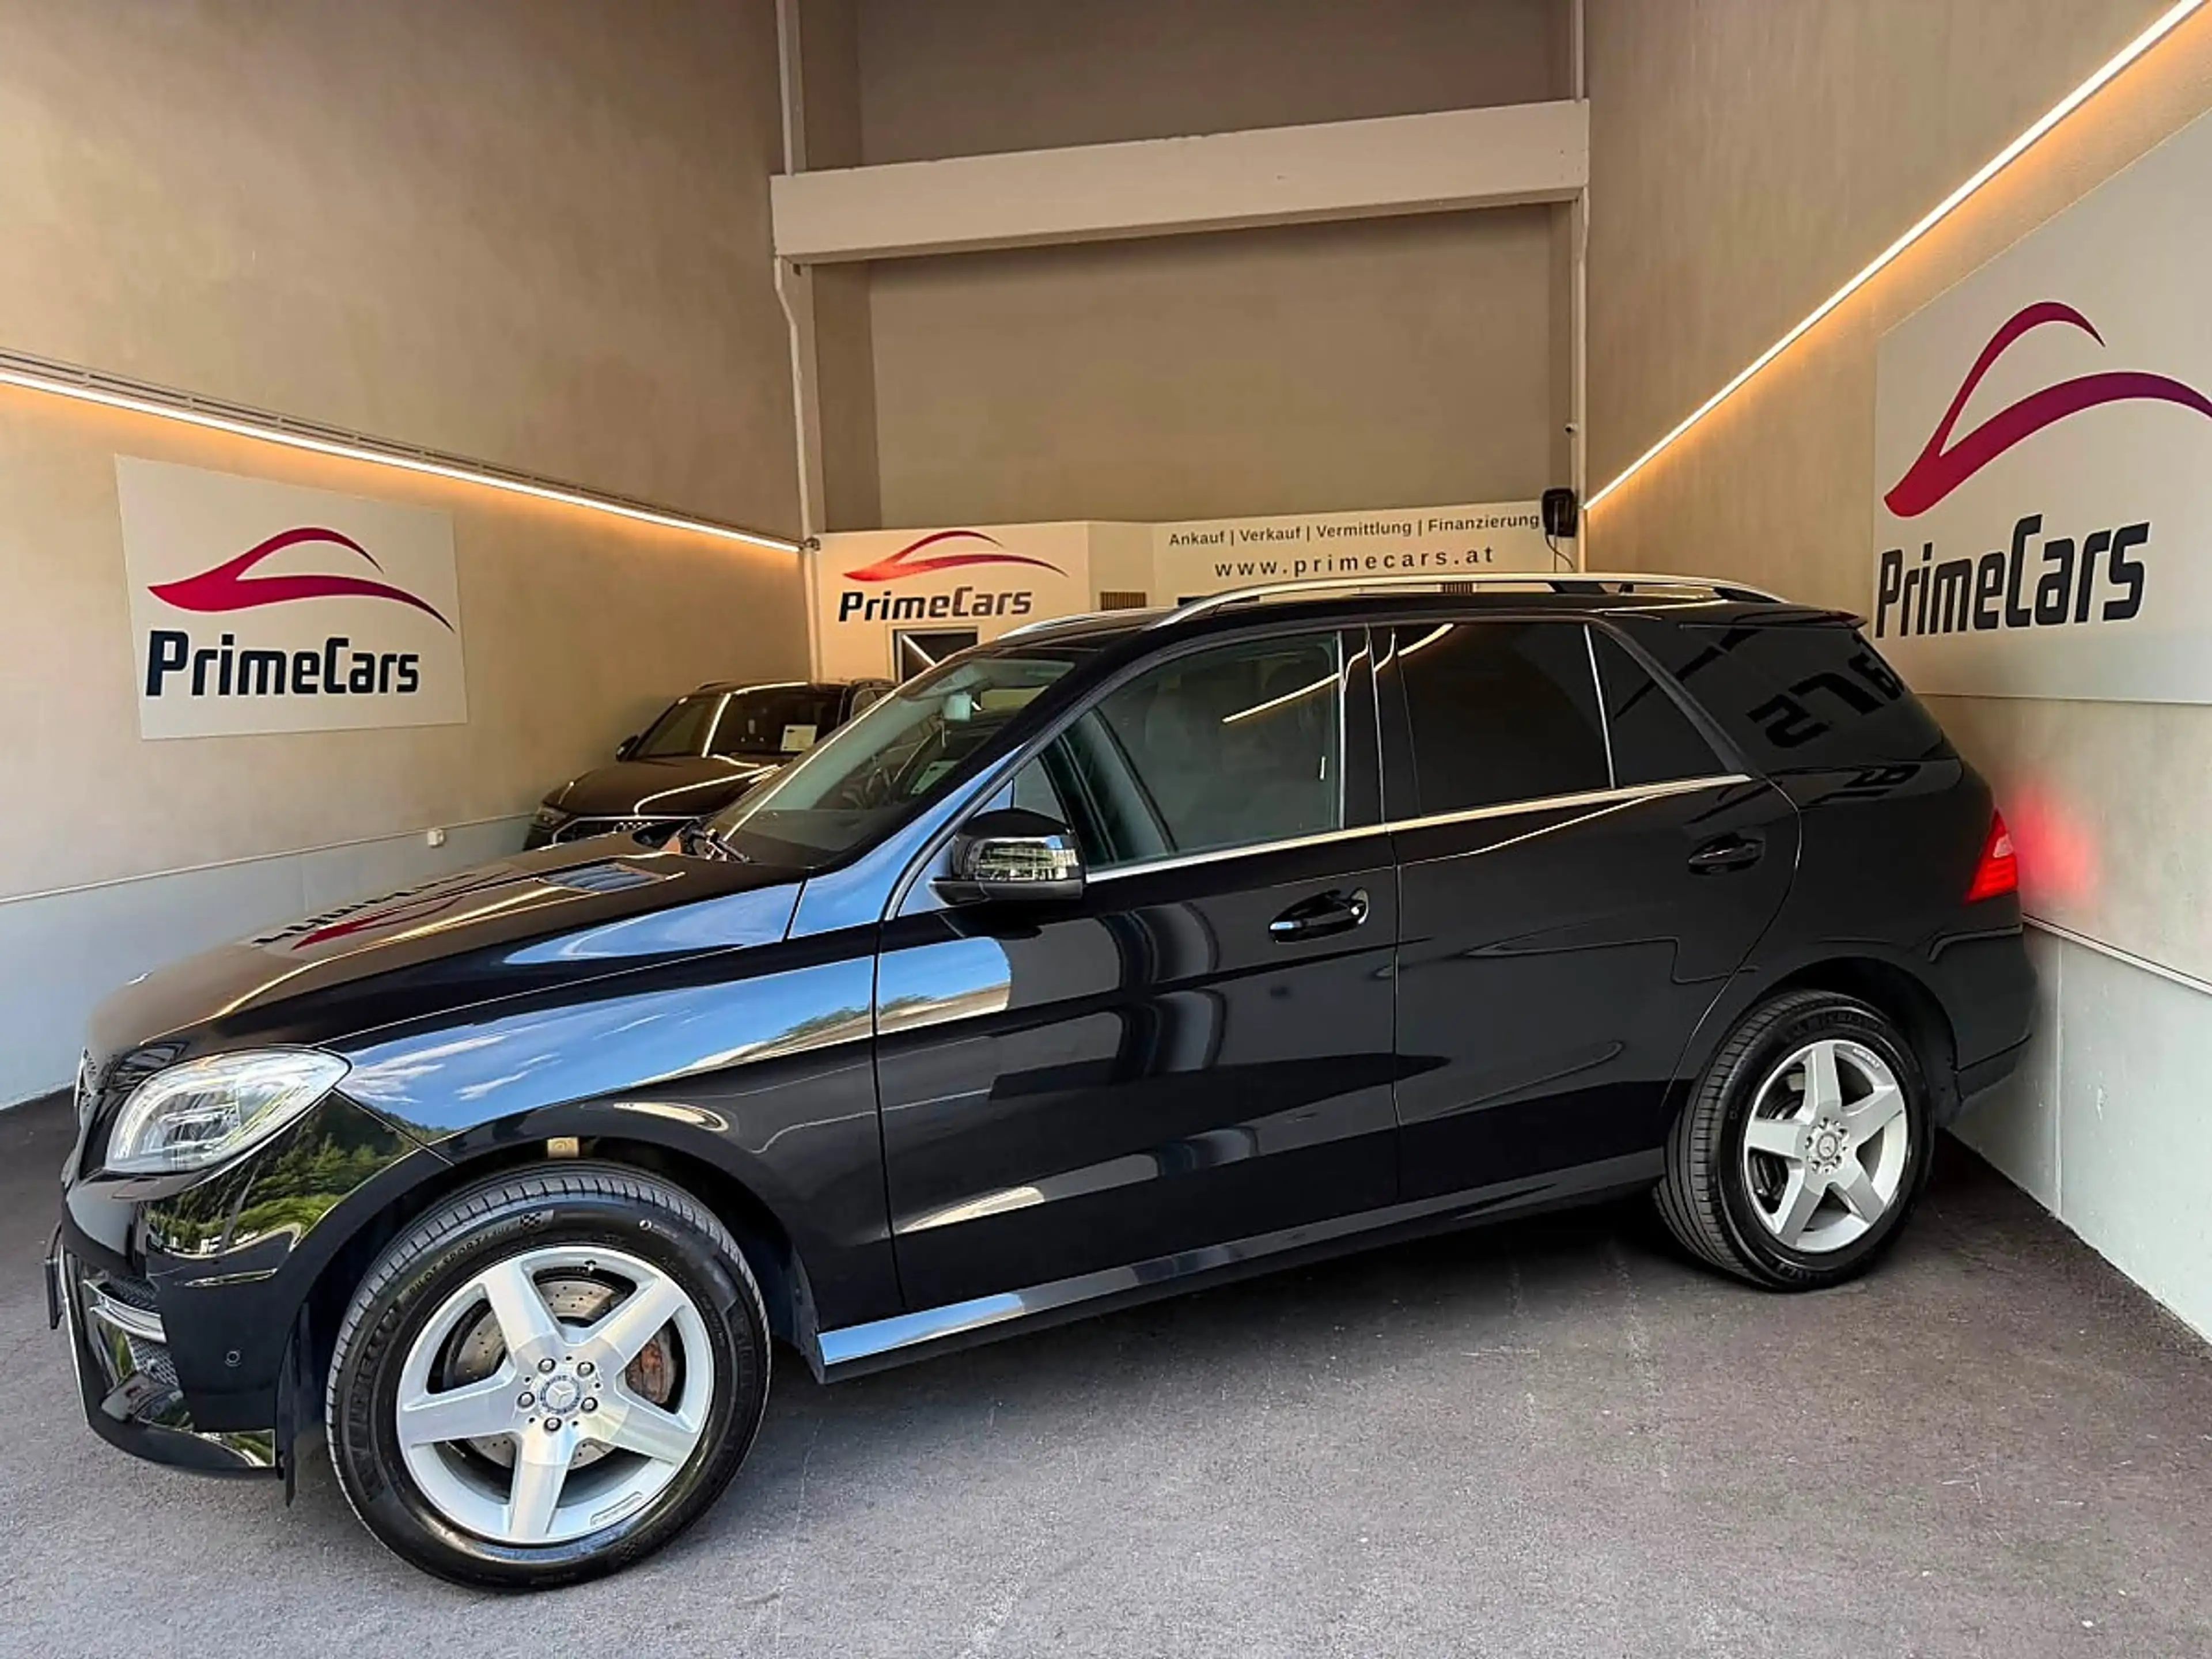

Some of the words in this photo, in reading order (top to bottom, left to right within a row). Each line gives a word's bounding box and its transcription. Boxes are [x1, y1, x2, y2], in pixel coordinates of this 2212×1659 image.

[1169, 531, 1225, 546] Ankauf
[1239, 526, 1301, 542] Verkauf
[1316, 521, 1411, 537] Vermittlung
[1427, 514, 1540, 533] Finanzierung
[1214, 546, 1493, 578] www.primecars.at
[1874, 514, 2150, 638] PrimeCars
[839, 586, 1032, 622] PrimeCars
[146, 630, 419, 696] PrimeCars
